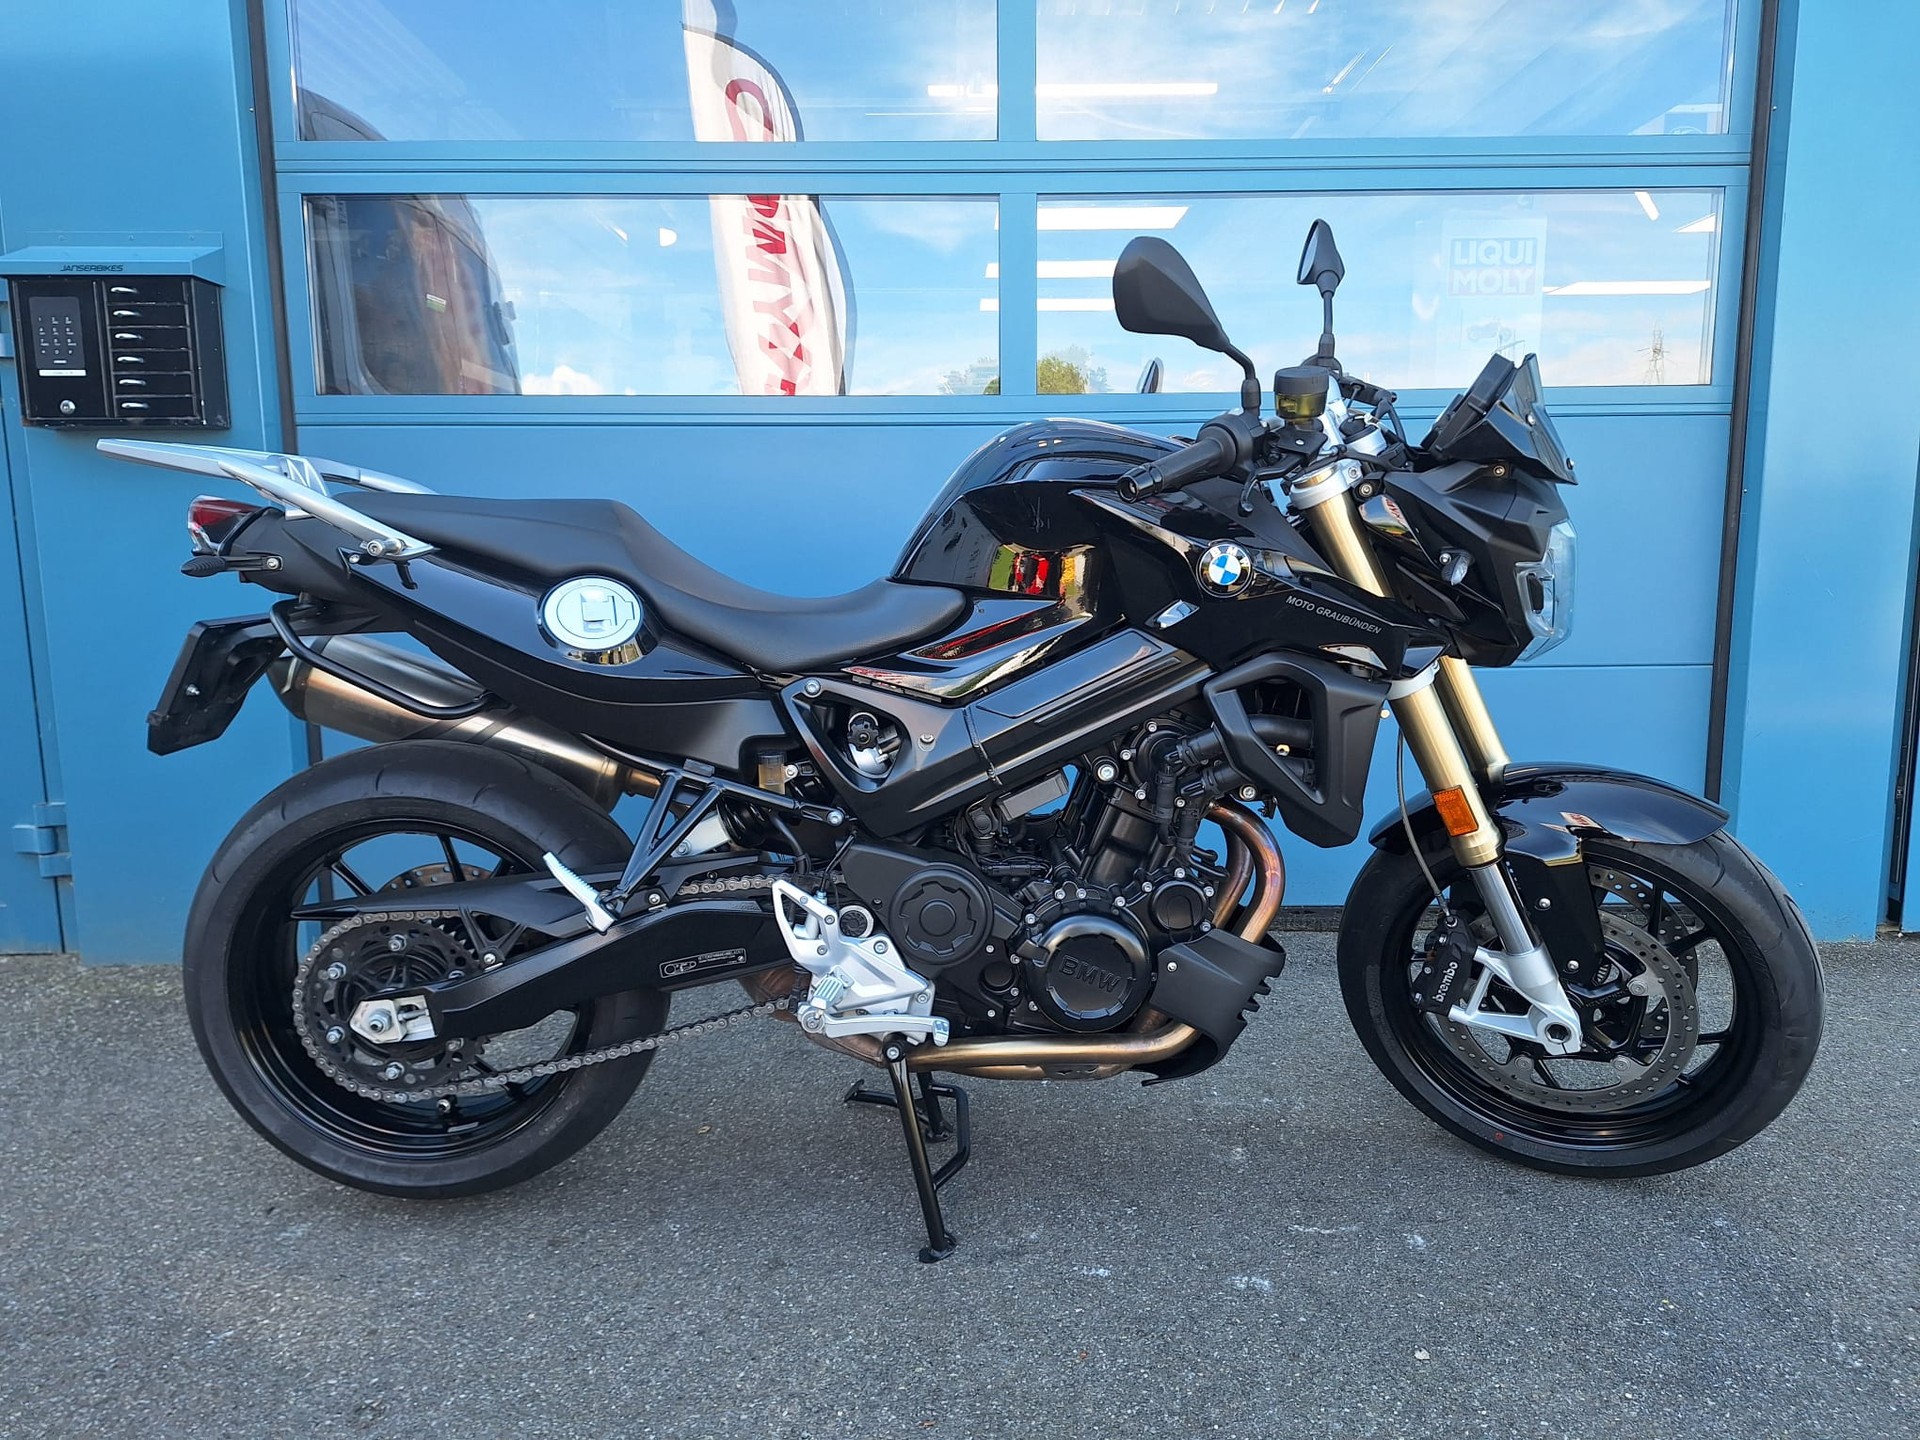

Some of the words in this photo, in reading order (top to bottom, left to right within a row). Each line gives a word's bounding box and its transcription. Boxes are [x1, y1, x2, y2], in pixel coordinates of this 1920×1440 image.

[1454, 239, 1534, 266] LIQUI
[1452, 269, 1535, 295] MOLY
[1285, 595, 1316, 614] MOTO
[1316, 606, 1383, 634] GRAUBÜNDEN
[1059, 954, 1122, 993] BMW
[1432, 961, 1459, 1003] brembo
